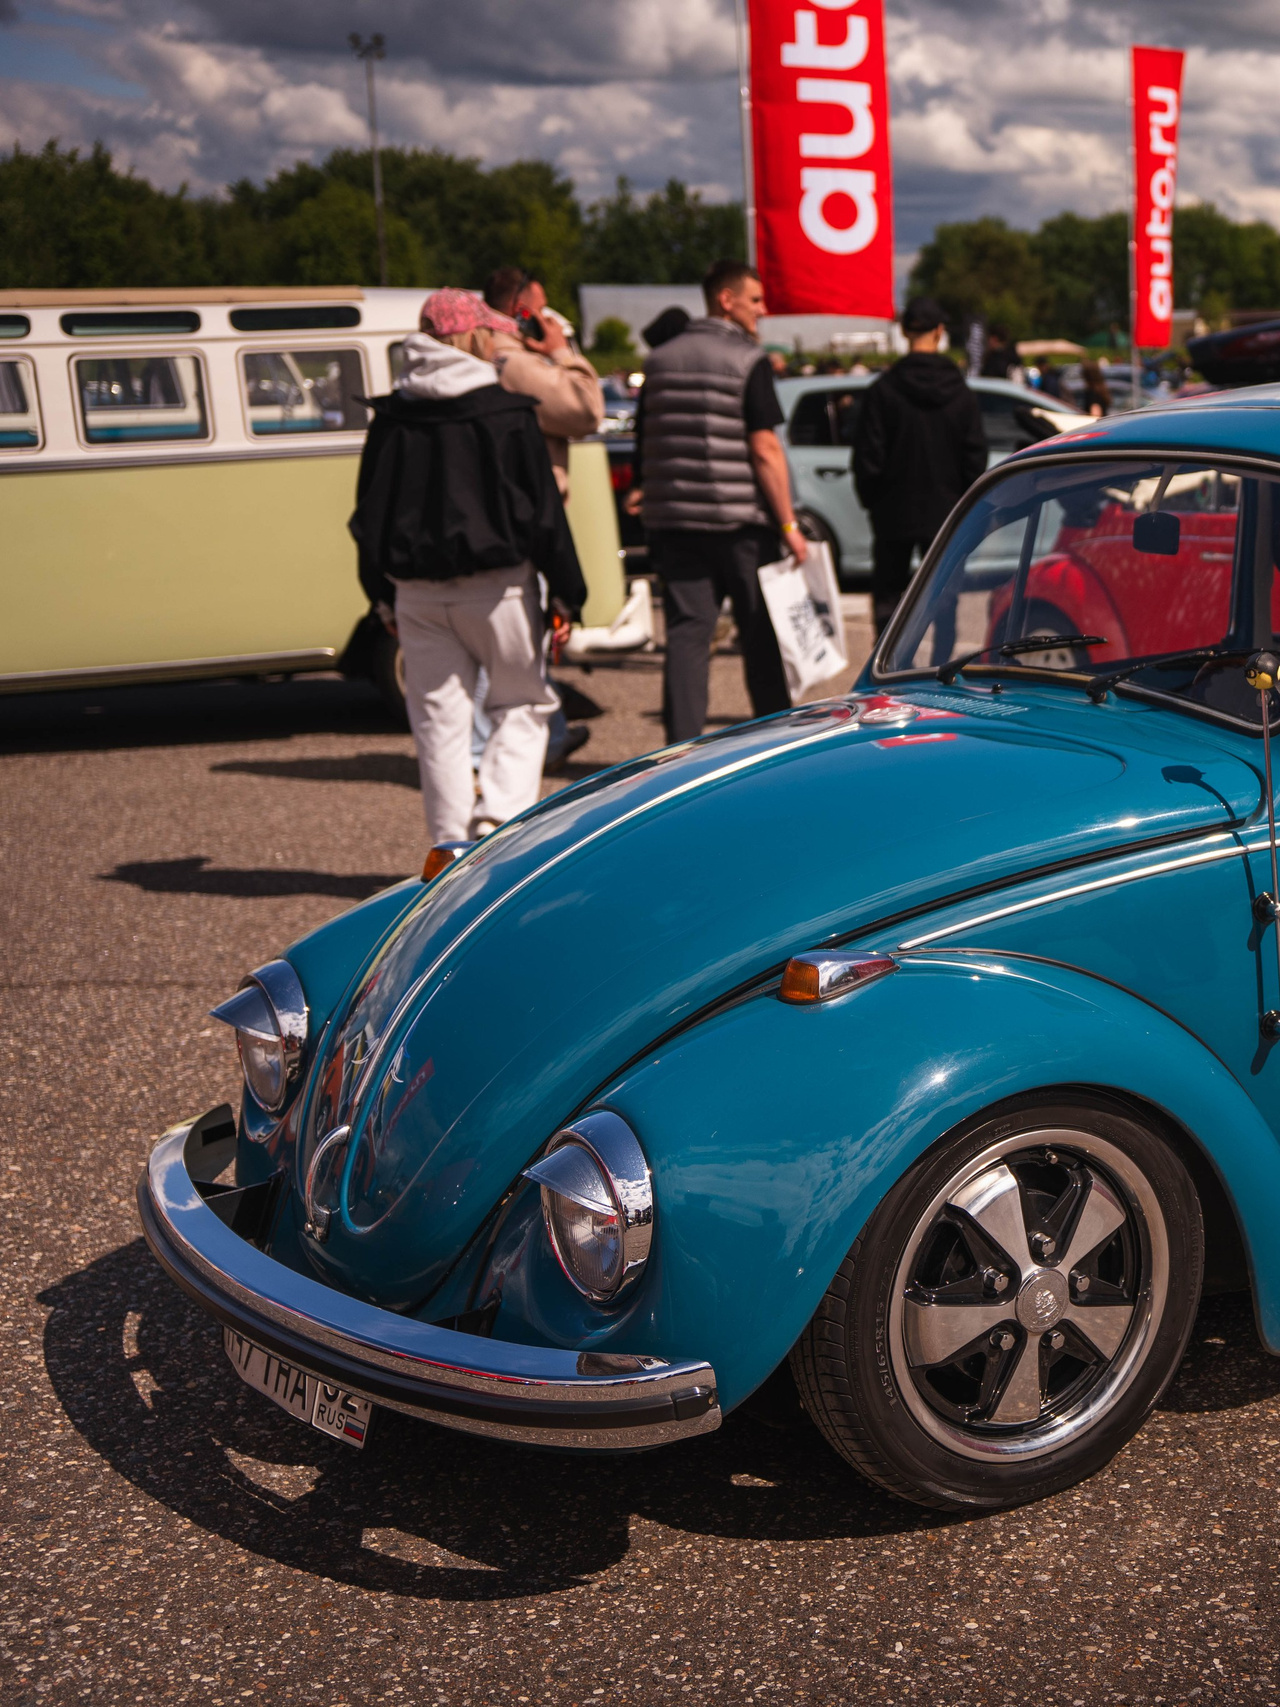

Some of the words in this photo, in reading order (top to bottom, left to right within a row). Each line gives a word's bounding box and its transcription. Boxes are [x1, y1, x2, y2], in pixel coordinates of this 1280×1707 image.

[780, 0, 879, 254] aut
[1145, 86, 1180, 321] auto.ru
[316, 1403, 346, 1431] RUS
